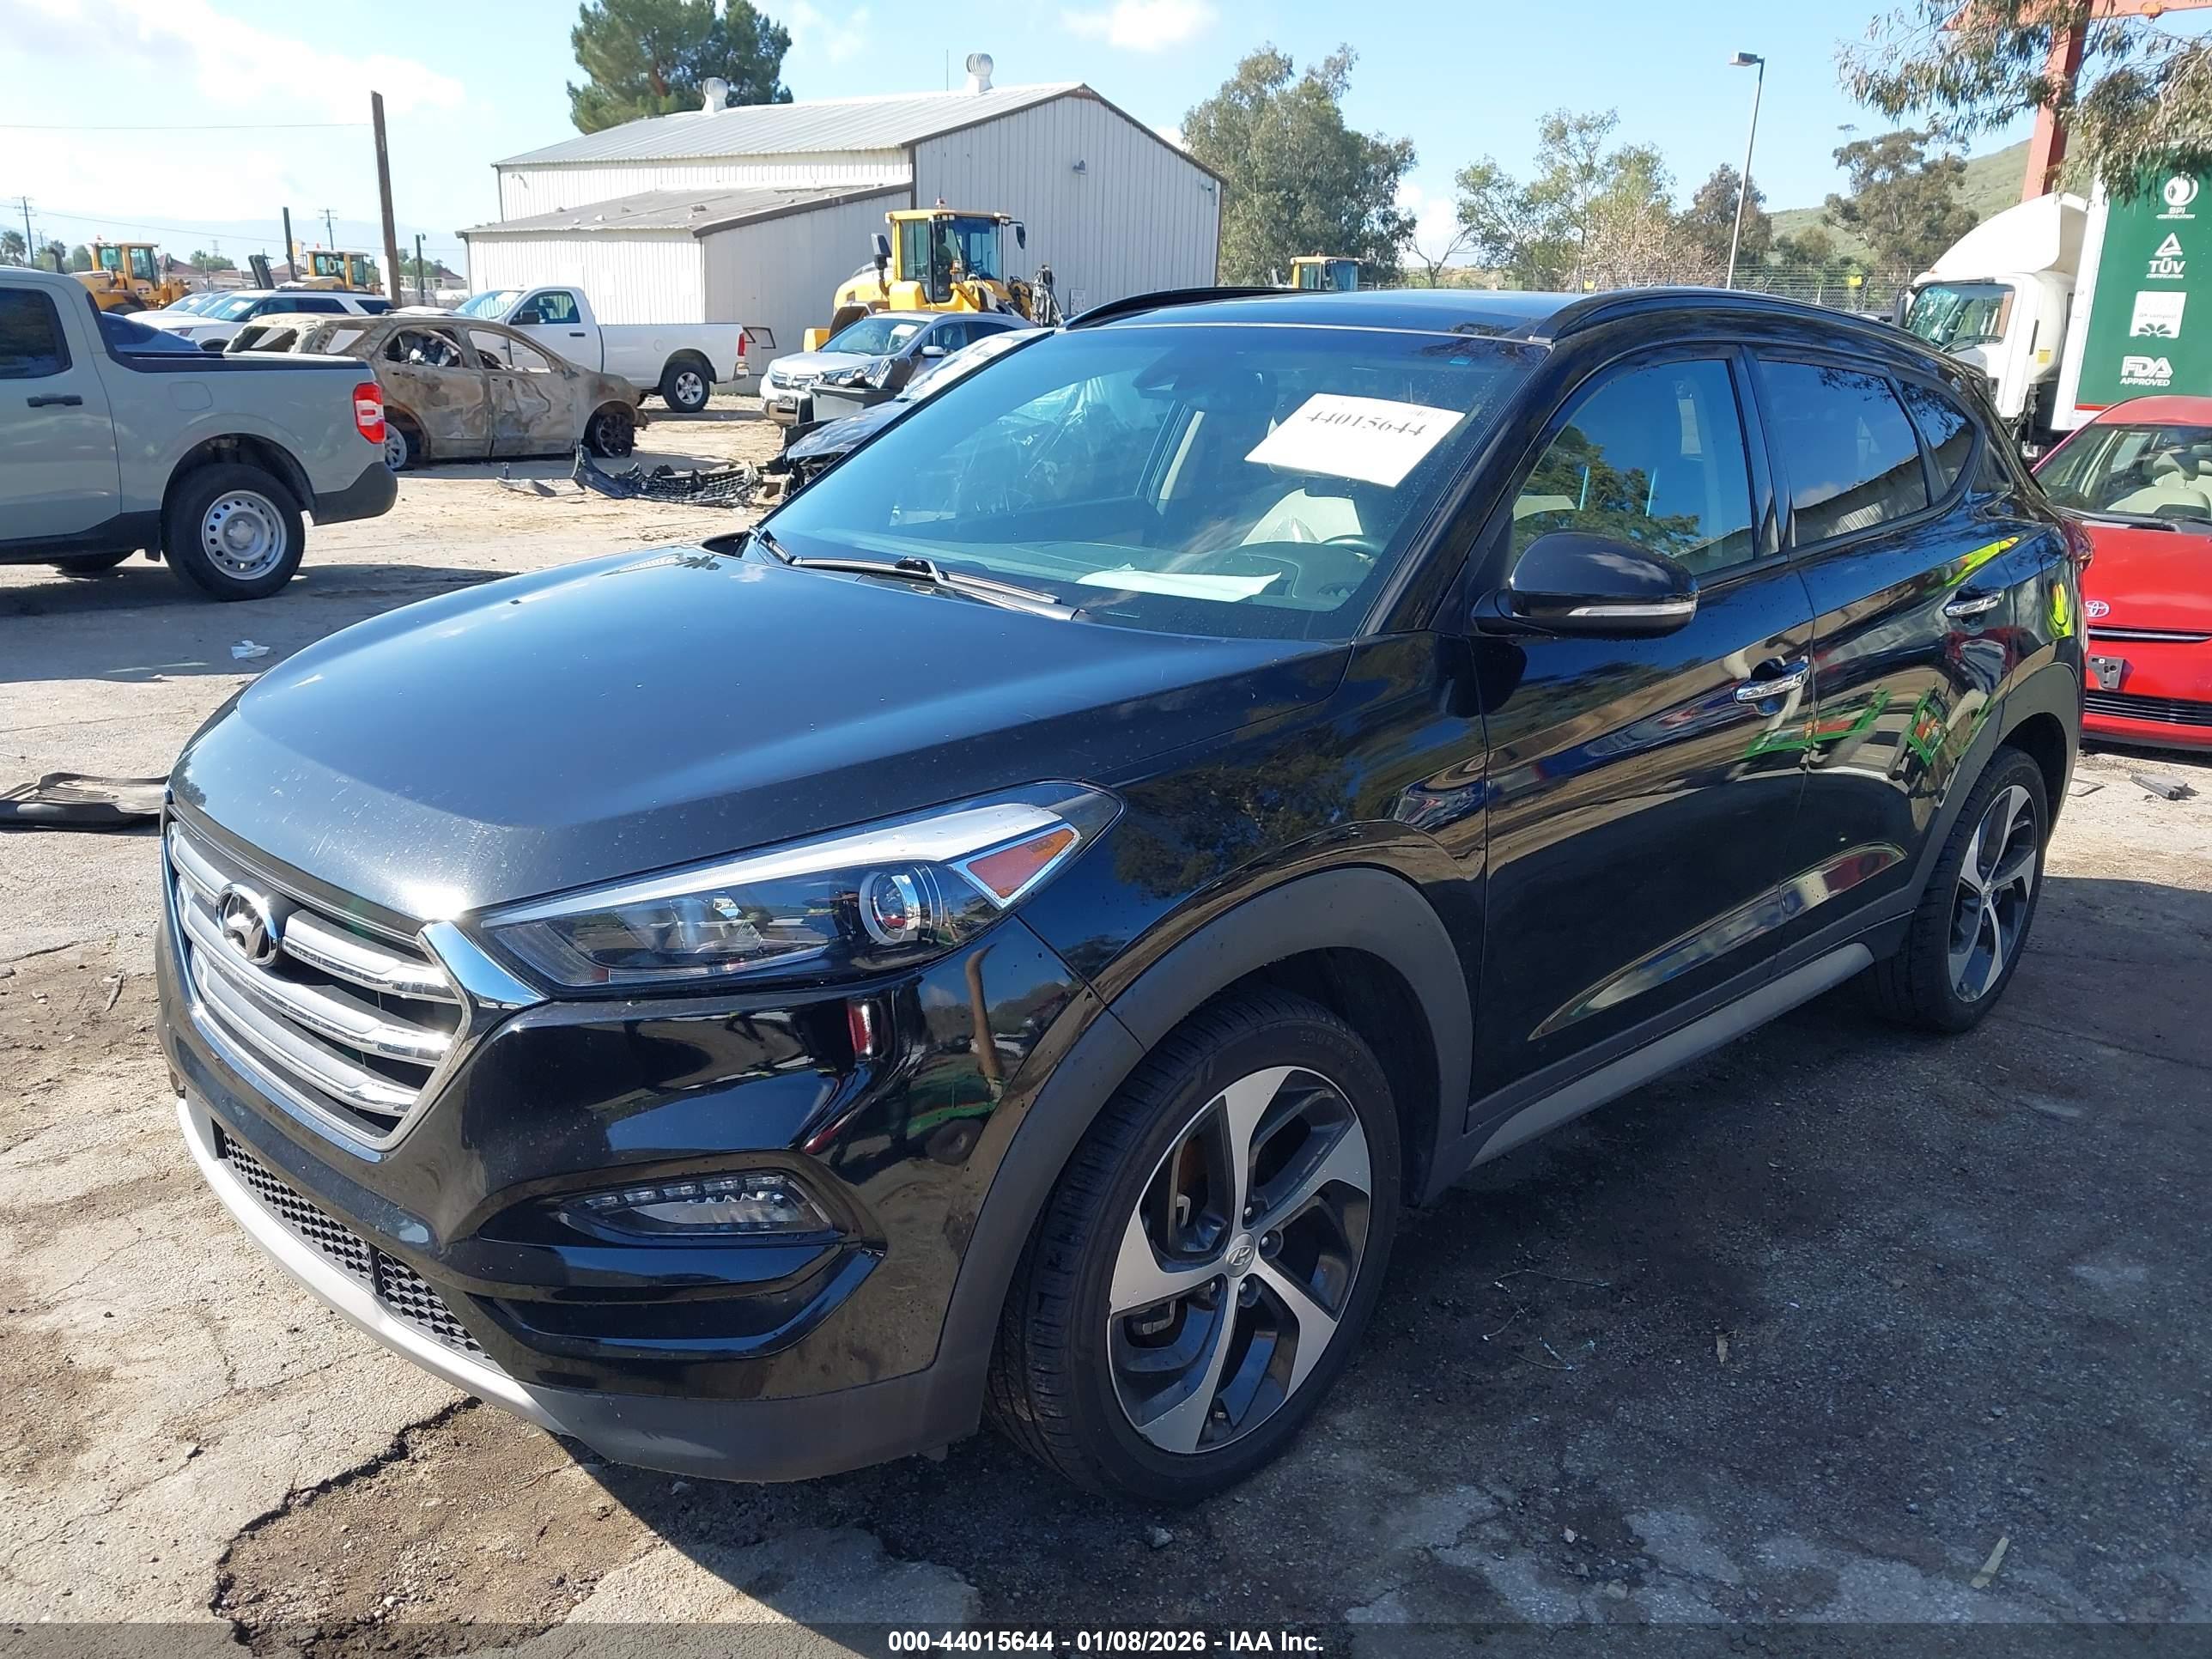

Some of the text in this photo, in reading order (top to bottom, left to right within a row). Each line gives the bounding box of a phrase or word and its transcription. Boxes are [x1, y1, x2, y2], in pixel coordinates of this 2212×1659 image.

[2168, 206, 2186, 215] BPI
[2148, 257, 2186, 274] TÜV
[2121, 356, 2173, 378] FDA
[2119, 377, 2171, 386] APPROVED
[1306, 410, 1427, 436] 44015644
